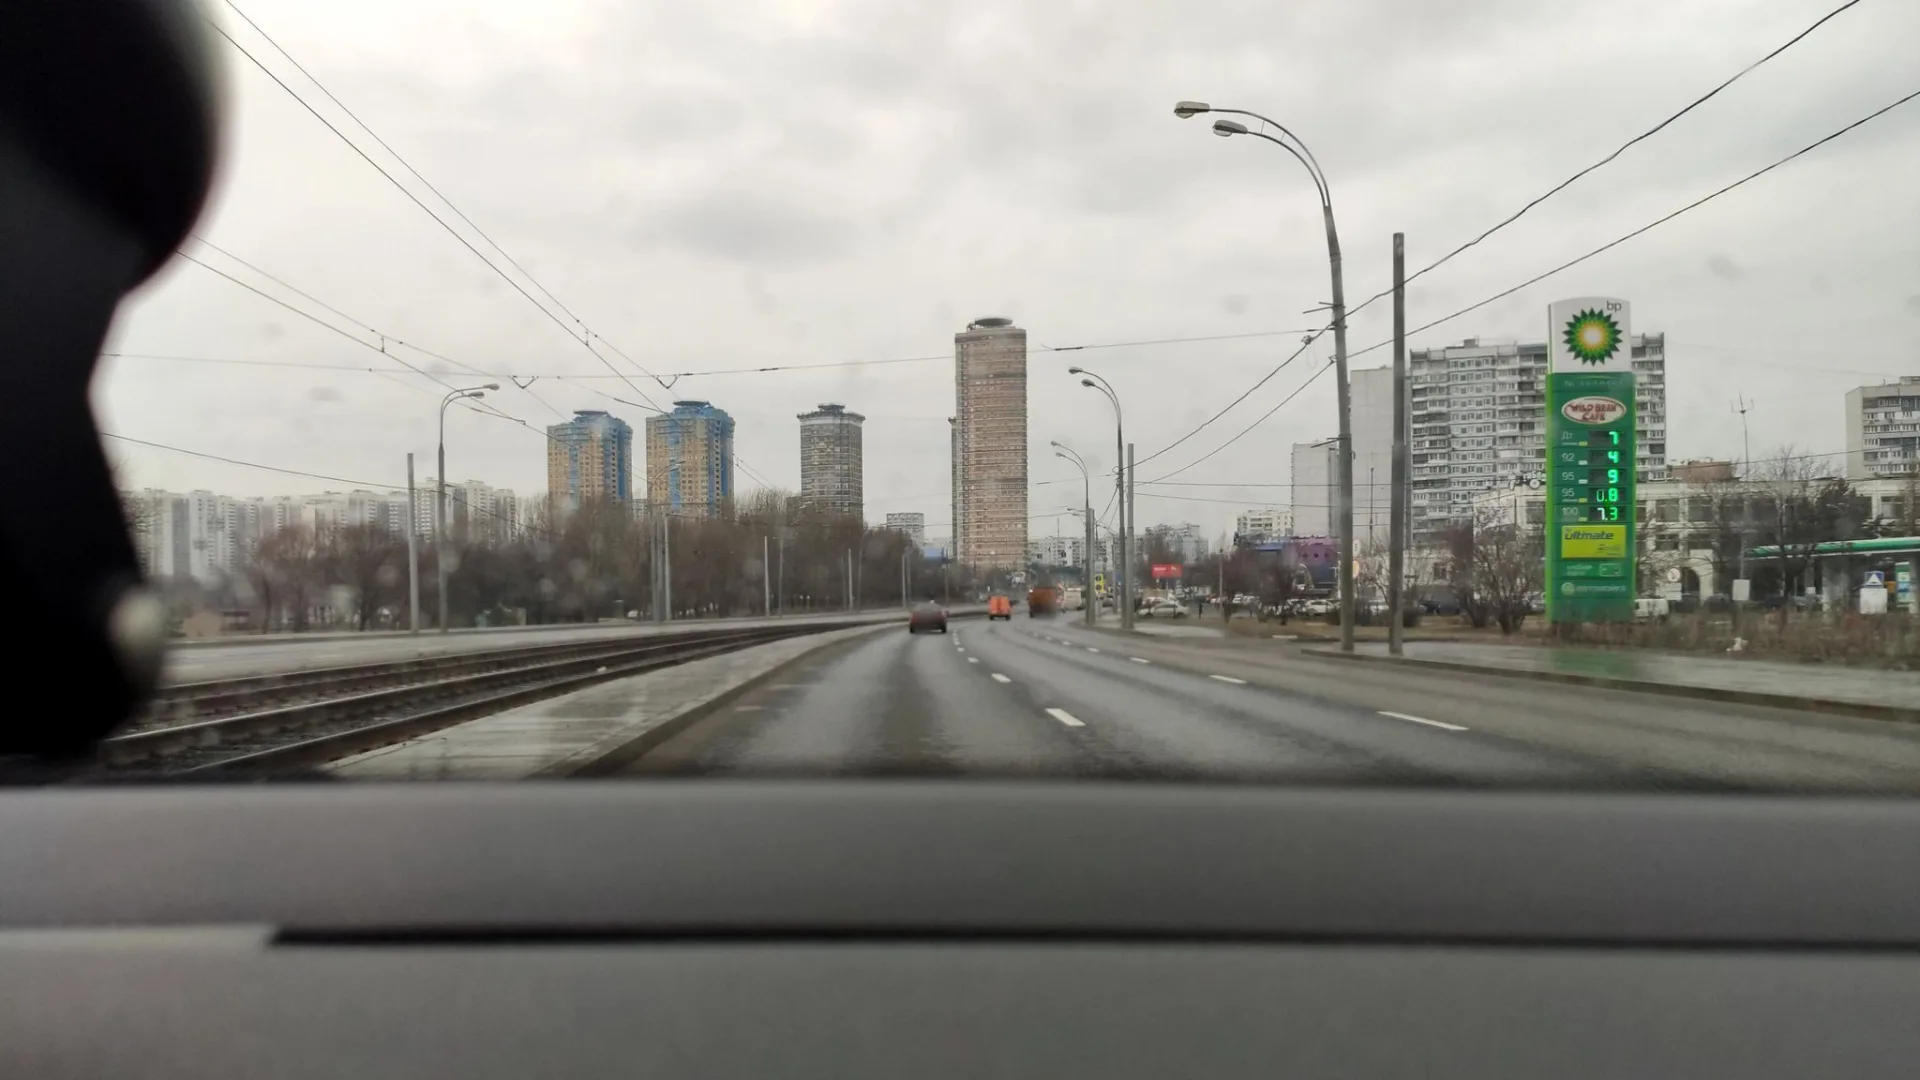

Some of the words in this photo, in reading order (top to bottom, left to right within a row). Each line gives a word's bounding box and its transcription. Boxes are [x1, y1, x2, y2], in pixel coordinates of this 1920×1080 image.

[1606, 300, 1622, 312] bp
[1561, 452, 1575, 462] 92
[1607, 450, 1619, 464] 4
[1561, 471, 1575, 481] 95
[1607, 469, 1619, 484] 9
[1561, 488, 1575, 497] 95
